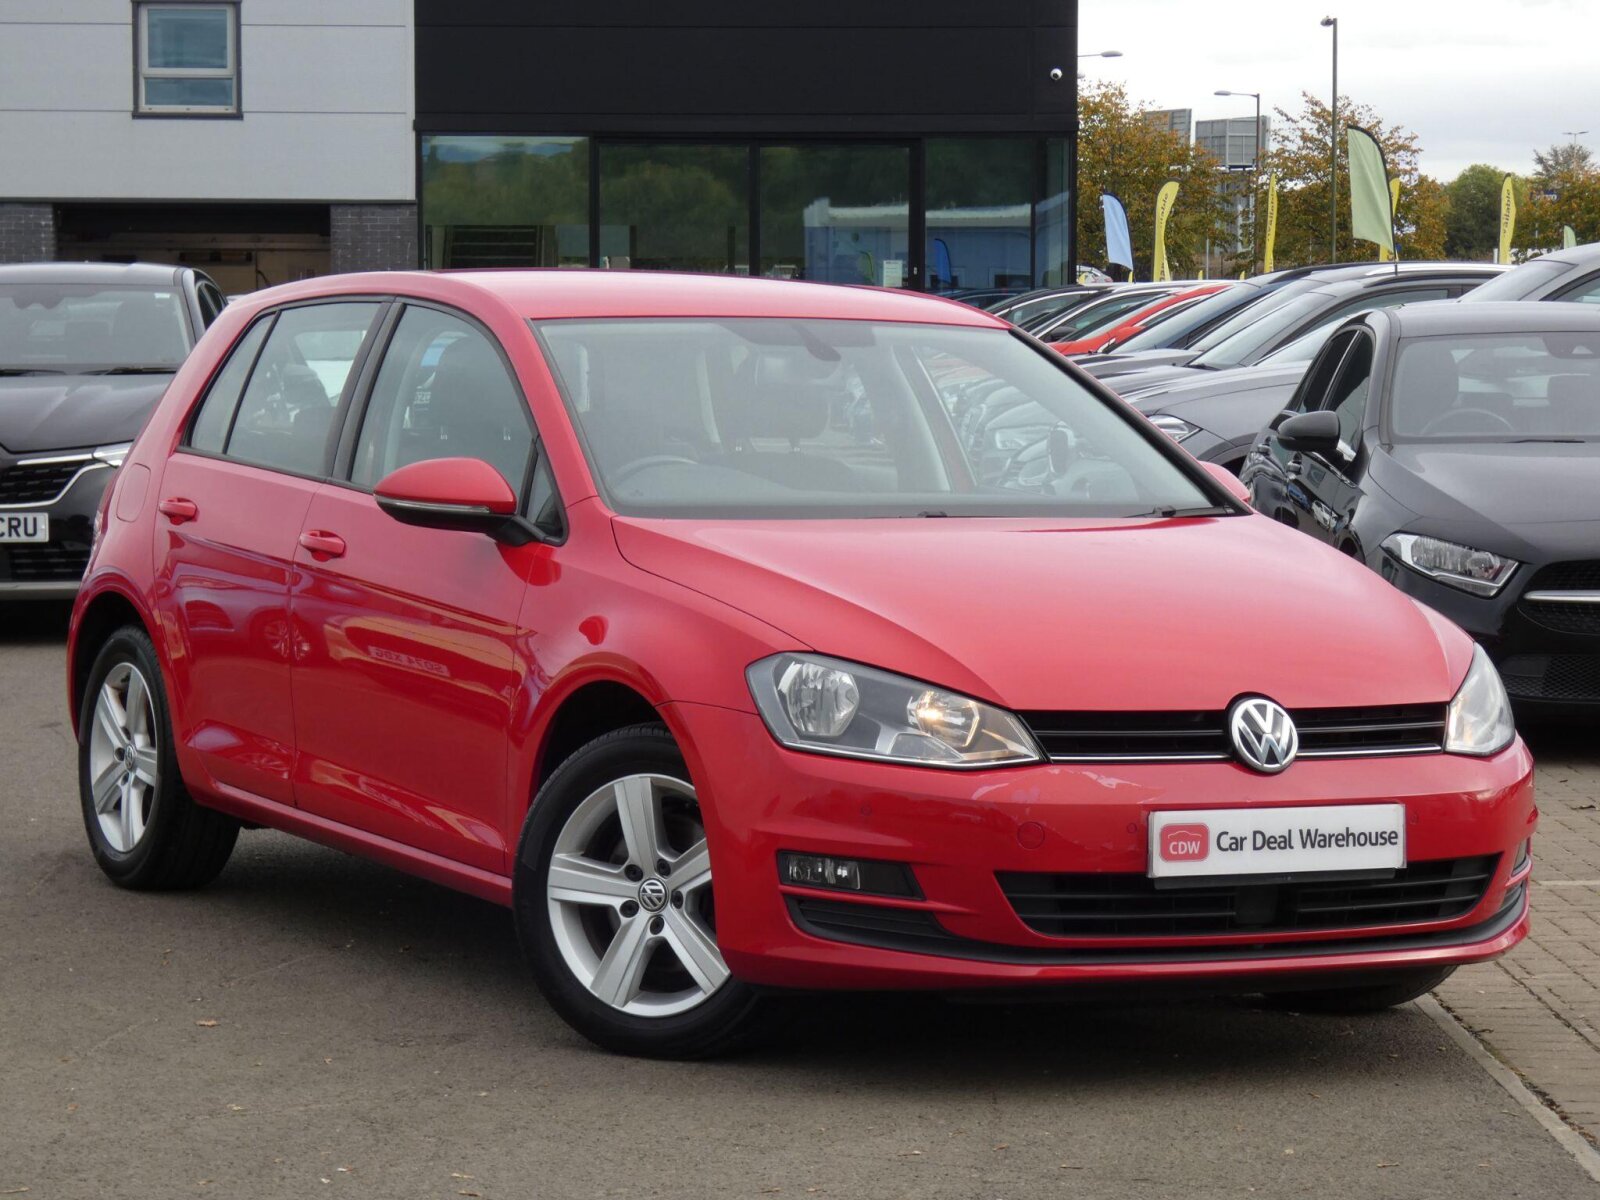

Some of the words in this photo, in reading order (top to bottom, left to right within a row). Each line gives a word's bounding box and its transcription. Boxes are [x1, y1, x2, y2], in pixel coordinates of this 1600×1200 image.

[1169, 840, 1201, 855] CDW
[1216, 831, 1248, 852] Car
[1252, 829, 1294, 851] Deal
[1299, 827, 1399, 849] Warehouse
